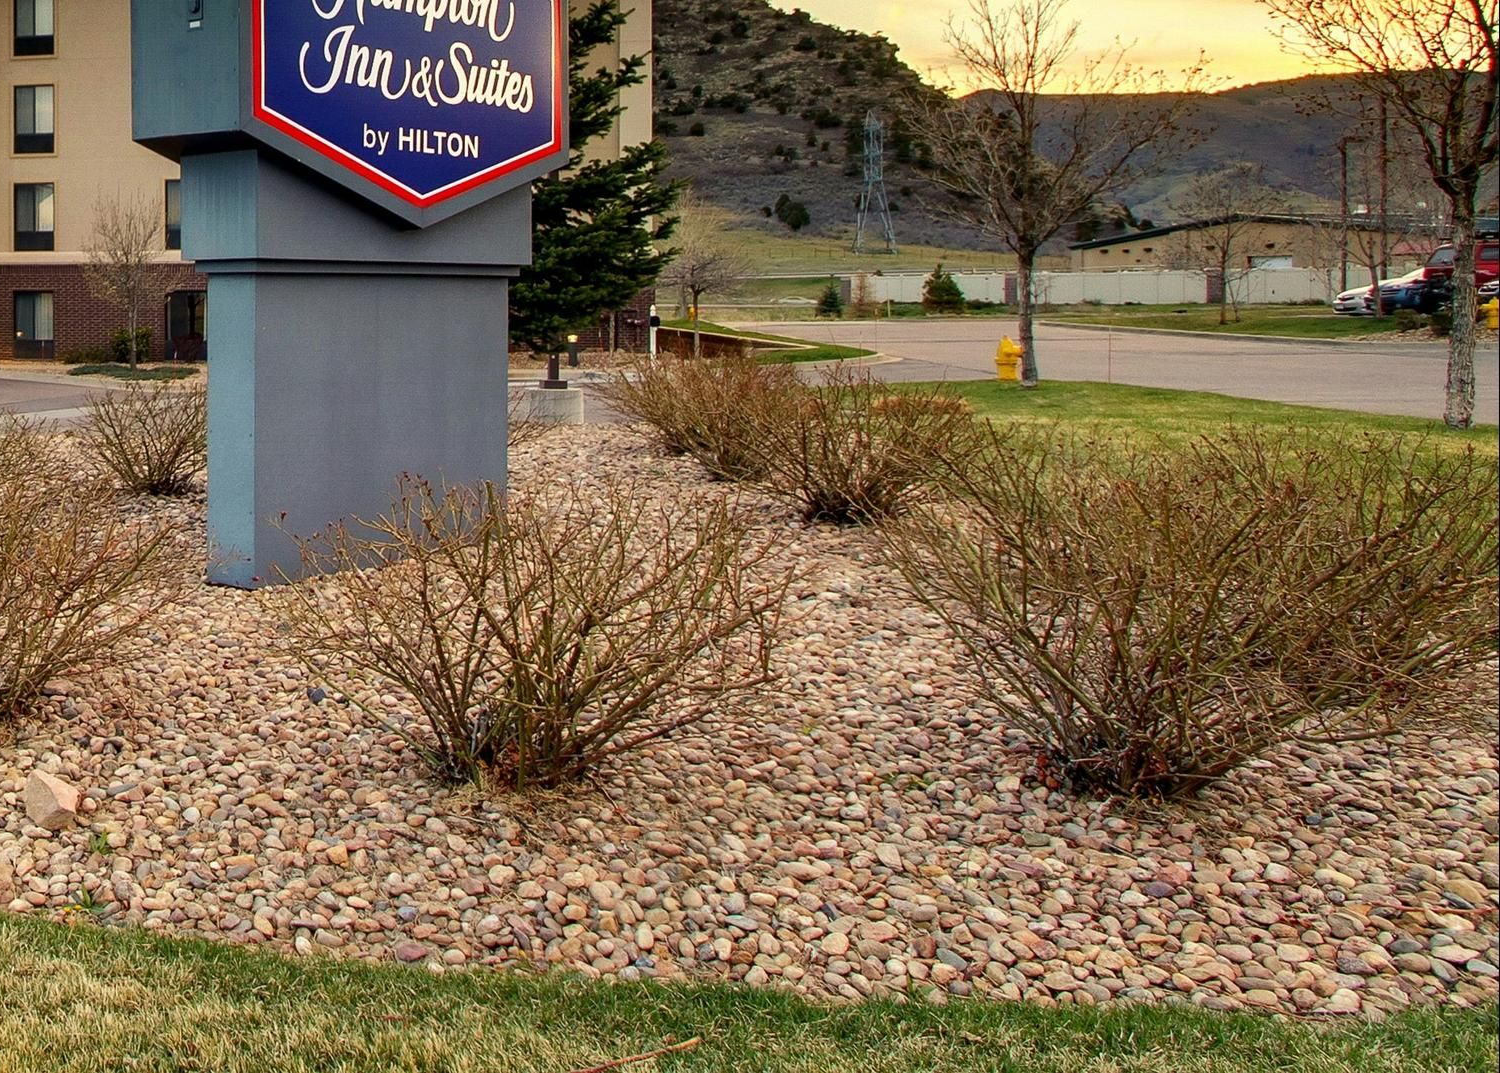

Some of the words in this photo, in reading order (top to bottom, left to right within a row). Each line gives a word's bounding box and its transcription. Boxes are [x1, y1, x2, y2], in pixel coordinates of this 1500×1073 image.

[299, 25, 411, 100] Inn
[411, 56, 438, 107] &
[434, 42, 534, 114] Suites
[363, 123, 390, 155] by
[398, 127, 480, 158] HILTON
